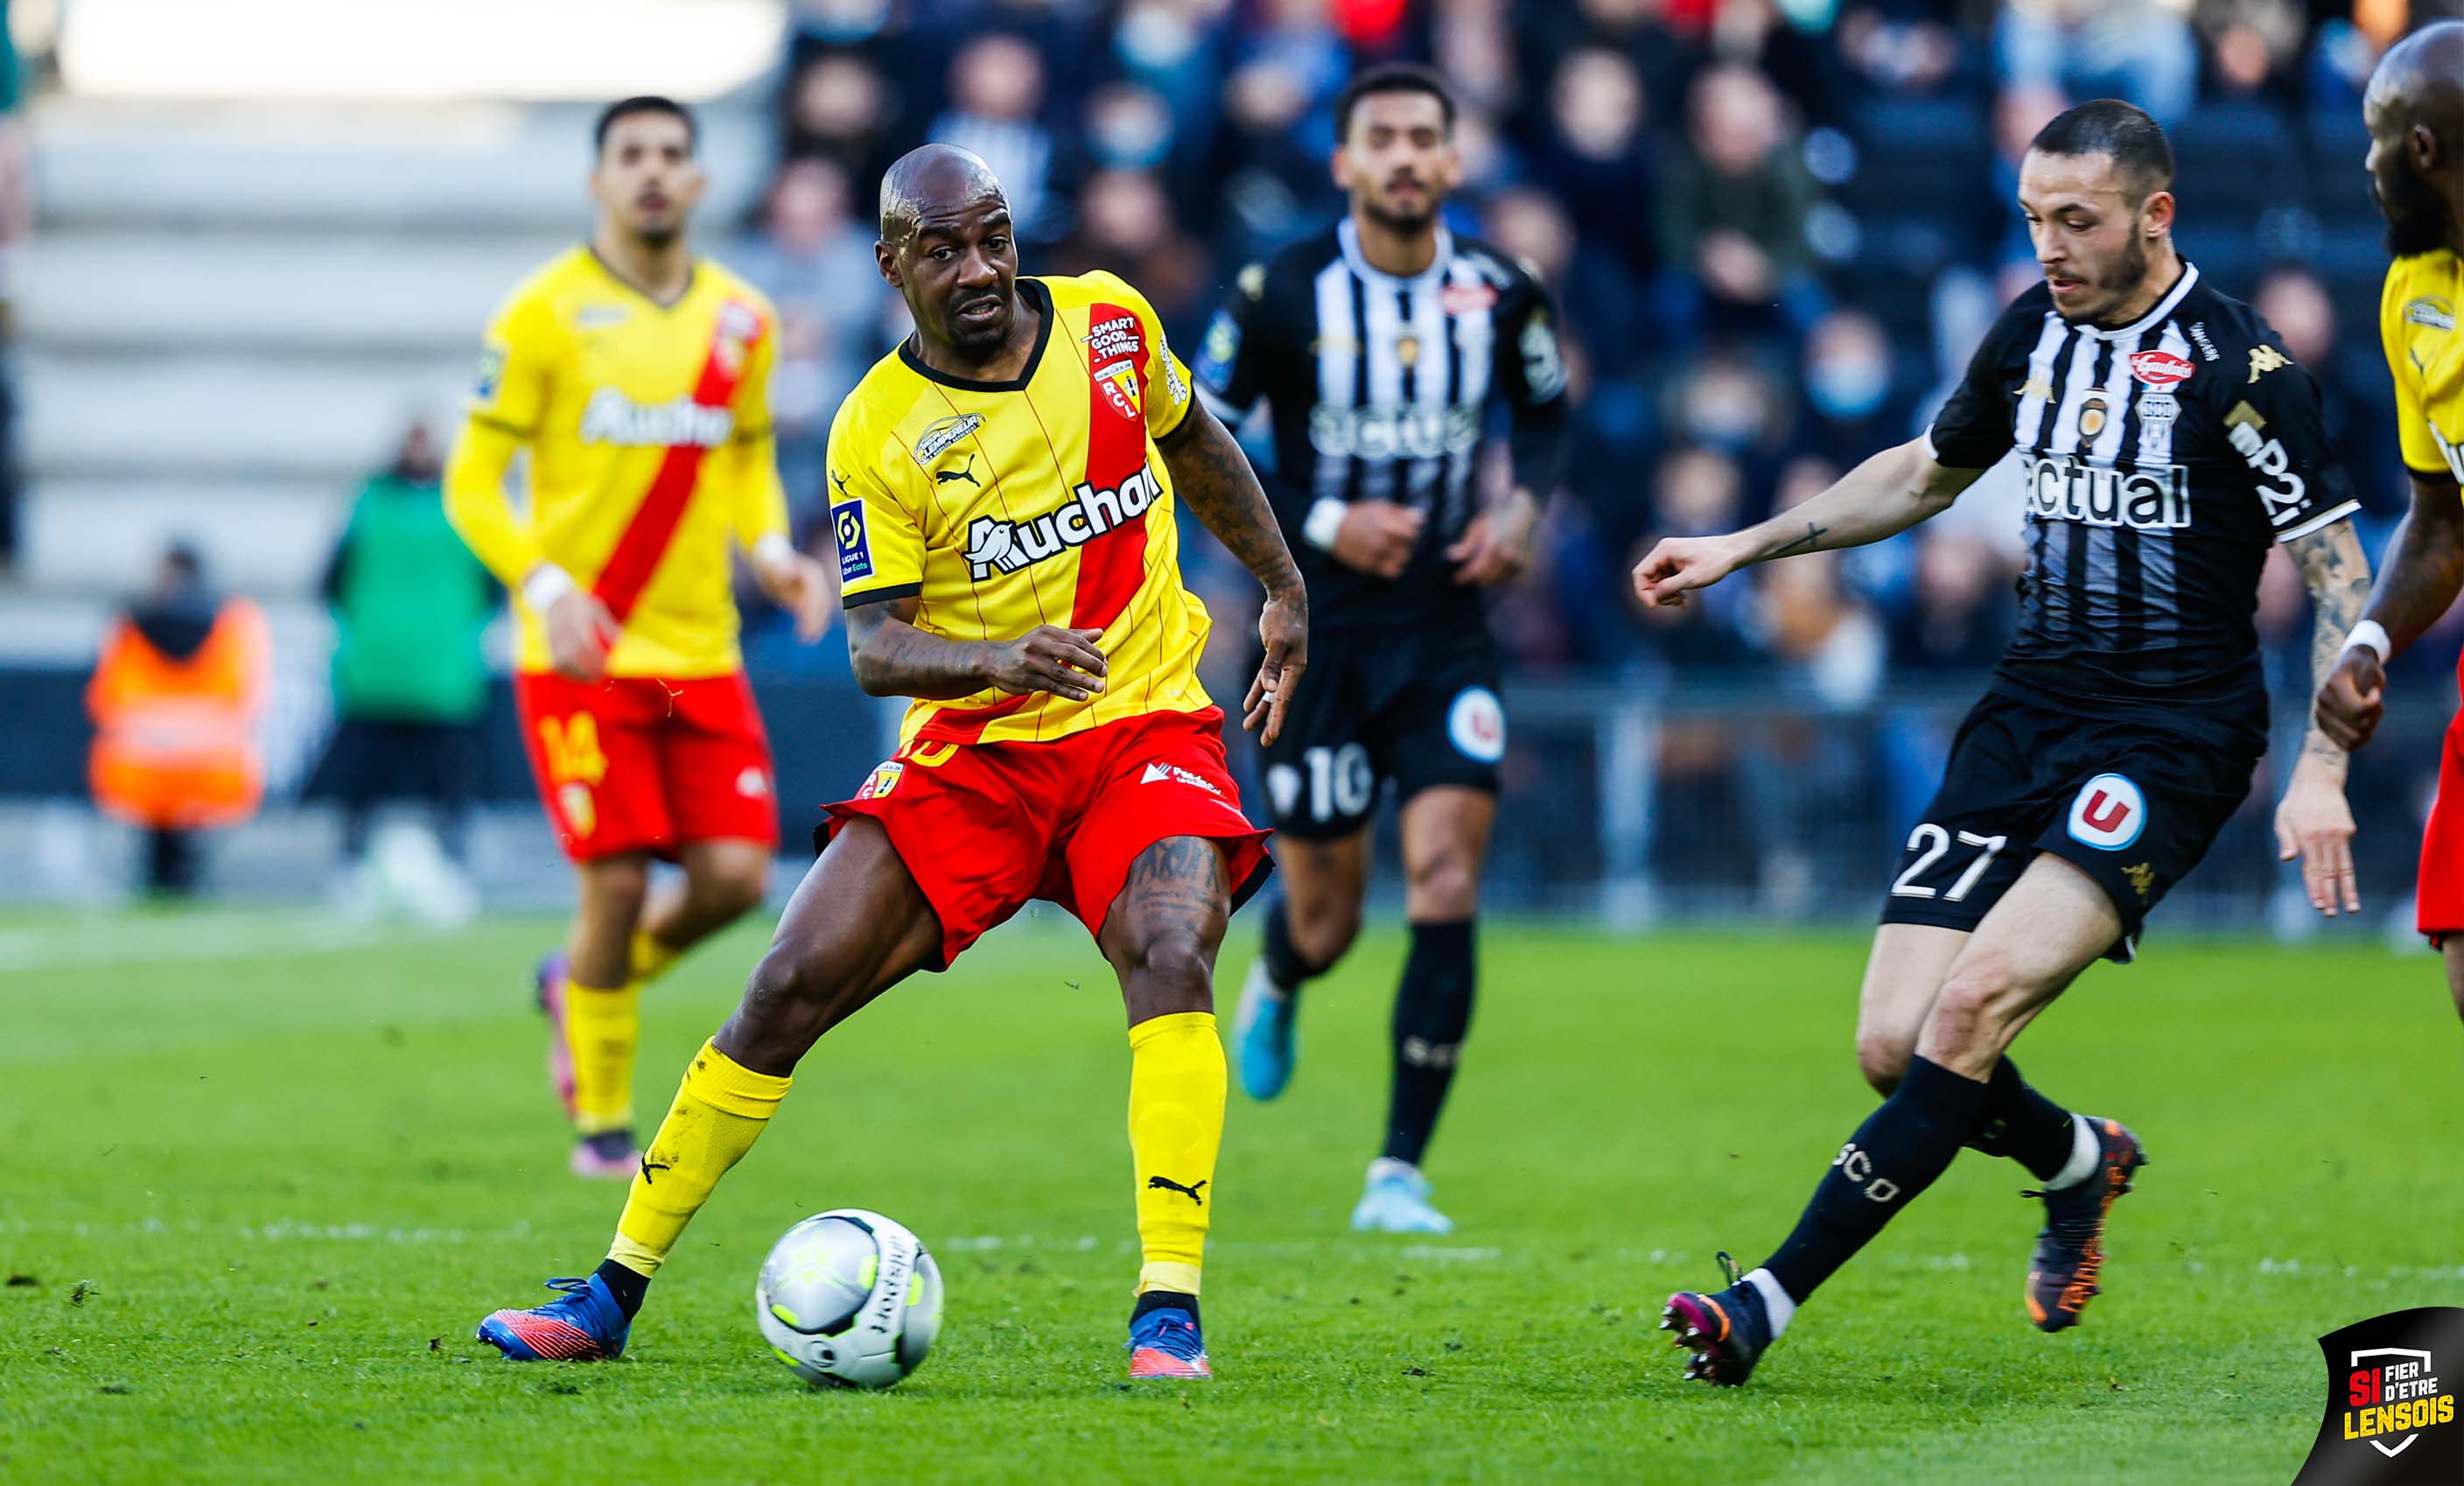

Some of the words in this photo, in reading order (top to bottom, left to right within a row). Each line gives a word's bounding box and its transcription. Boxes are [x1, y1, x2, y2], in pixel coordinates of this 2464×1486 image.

[1091, 317, 1134, 338] SMART
[1091, 330, 1127, 350] GOOD
[1098, 340, 1139, 360] THINGS
[923, 416, 978, 456] LEMPEREUR
[842, 552, 859, 564] LIGUE
[539, 711, 609, 787] 14
[1303, 742, 1374, 824] 10
[2082, 789, 2132, 833] U
[1890, 823, 2008, 902] 27
[1831, 1142, 1900, 1202] SCO
